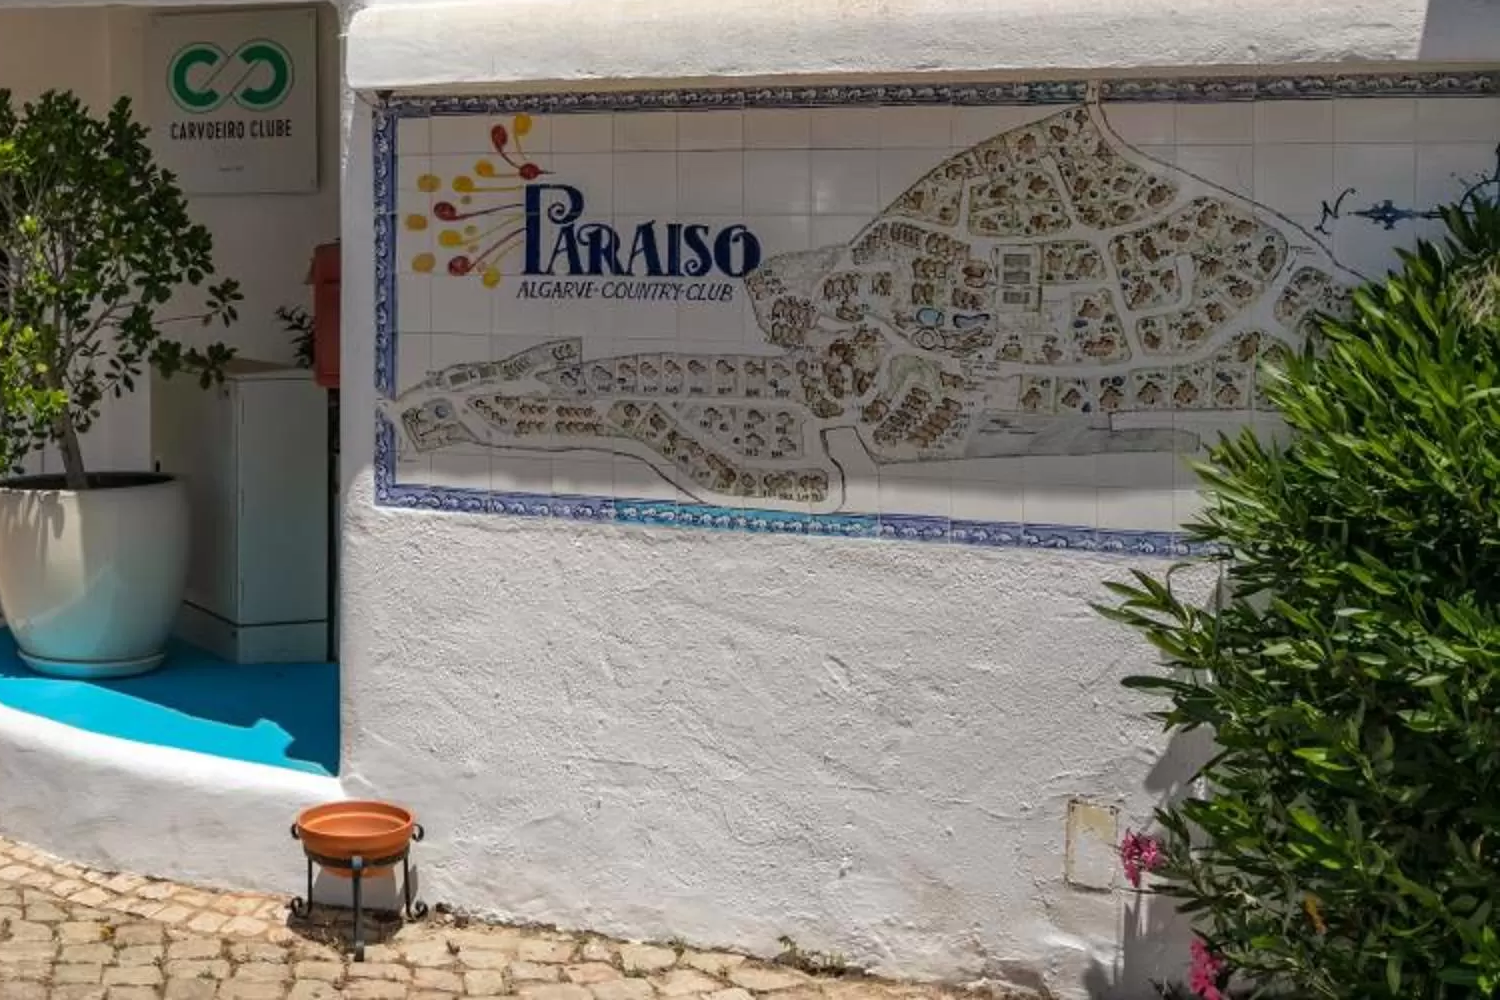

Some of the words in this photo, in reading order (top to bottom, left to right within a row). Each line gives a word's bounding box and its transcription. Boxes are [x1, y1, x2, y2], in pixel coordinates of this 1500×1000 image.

[171, 121, 244, 140] CARVOEIRO
[251, 119, 293, 138] CLUBE
[521, 184, 761, 277] PARAISO
